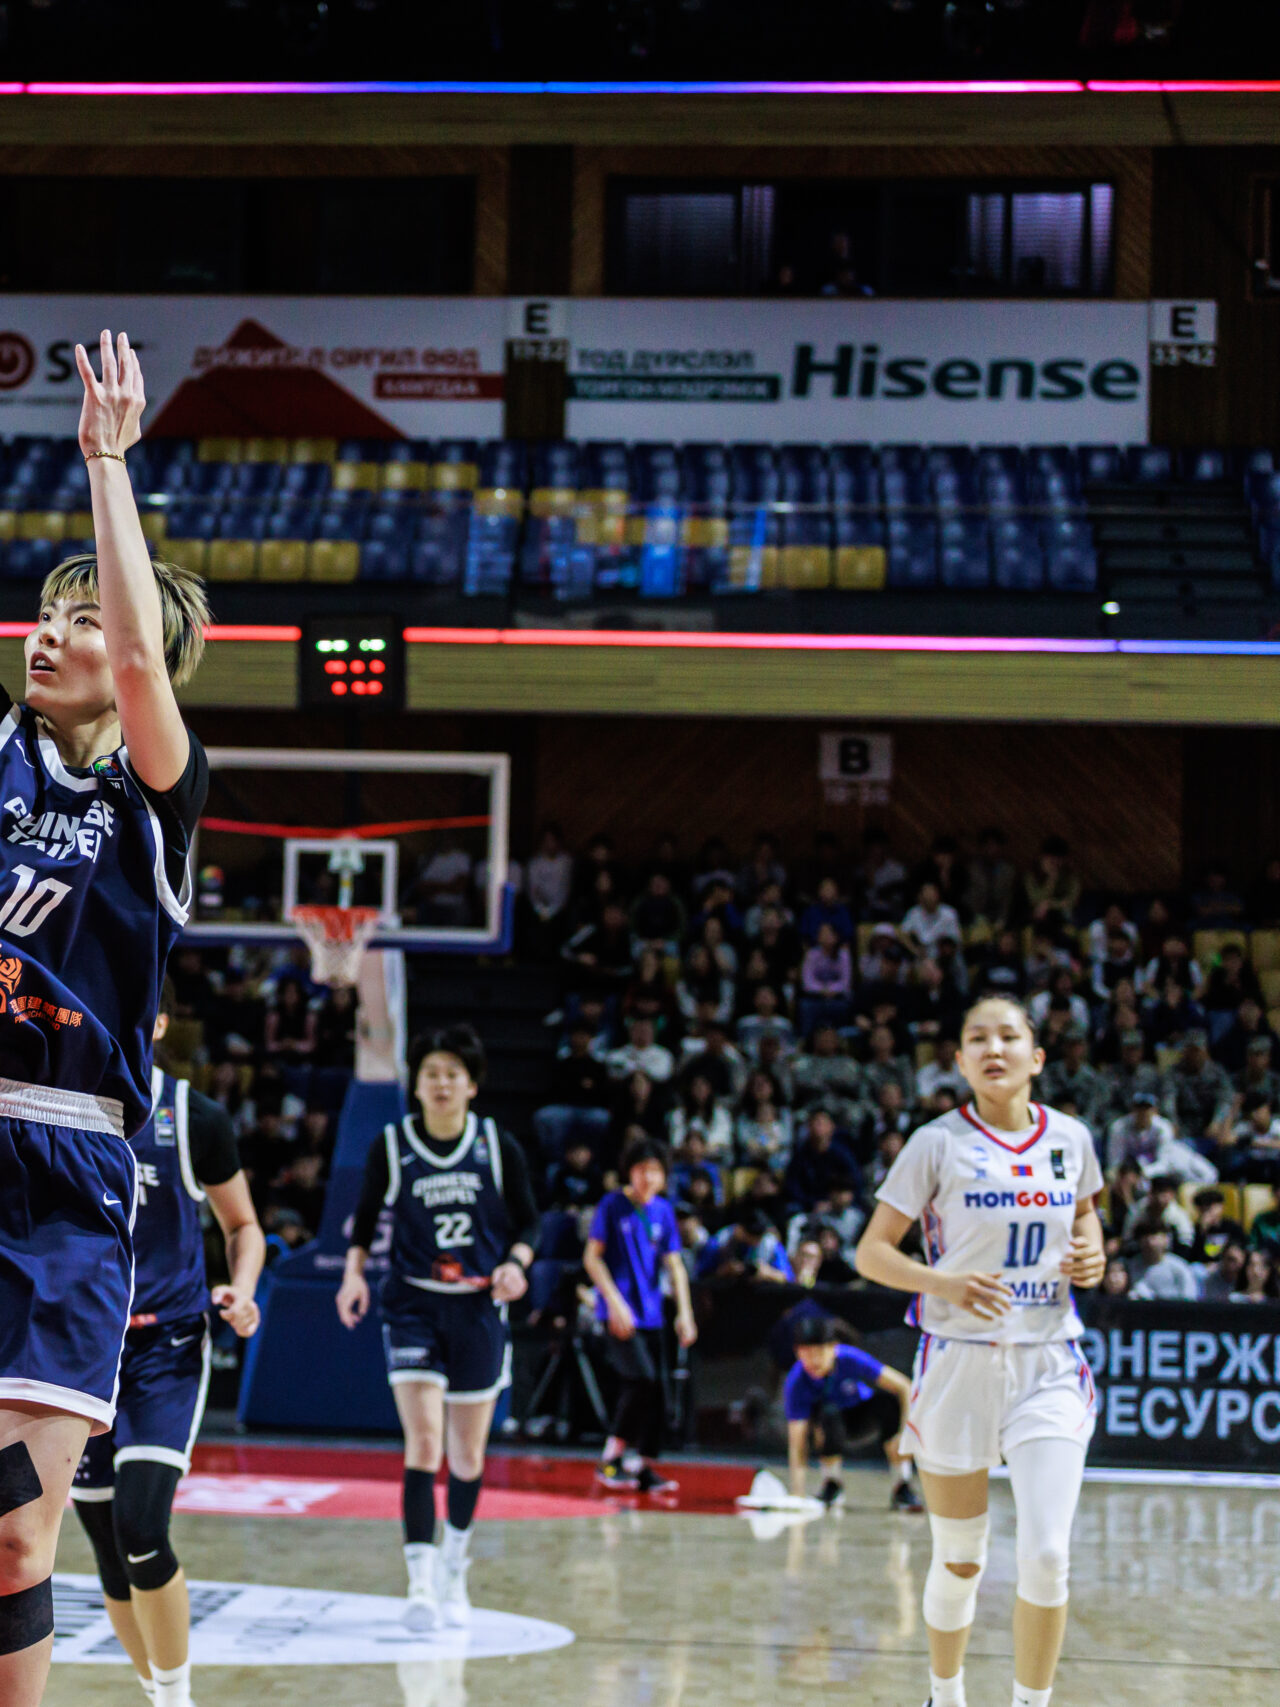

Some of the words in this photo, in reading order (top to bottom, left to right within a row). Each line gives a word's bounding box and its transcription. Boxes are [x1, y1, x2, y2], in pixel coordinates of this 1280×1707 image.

[525, 303, 550, 334] E
[1170, 306, 1196, 338] E
[791, 343, 1140, 402] Hisense
[840, 739, 870, 774] B
[433, 1212, 474, 1250] 22
[1003, 1221, 1046, 1268] 10
[1081, 1328, 1280, 1383] ЭНЕРЖ
[1096, 1385, 1280, 1444] ЕСУРС
